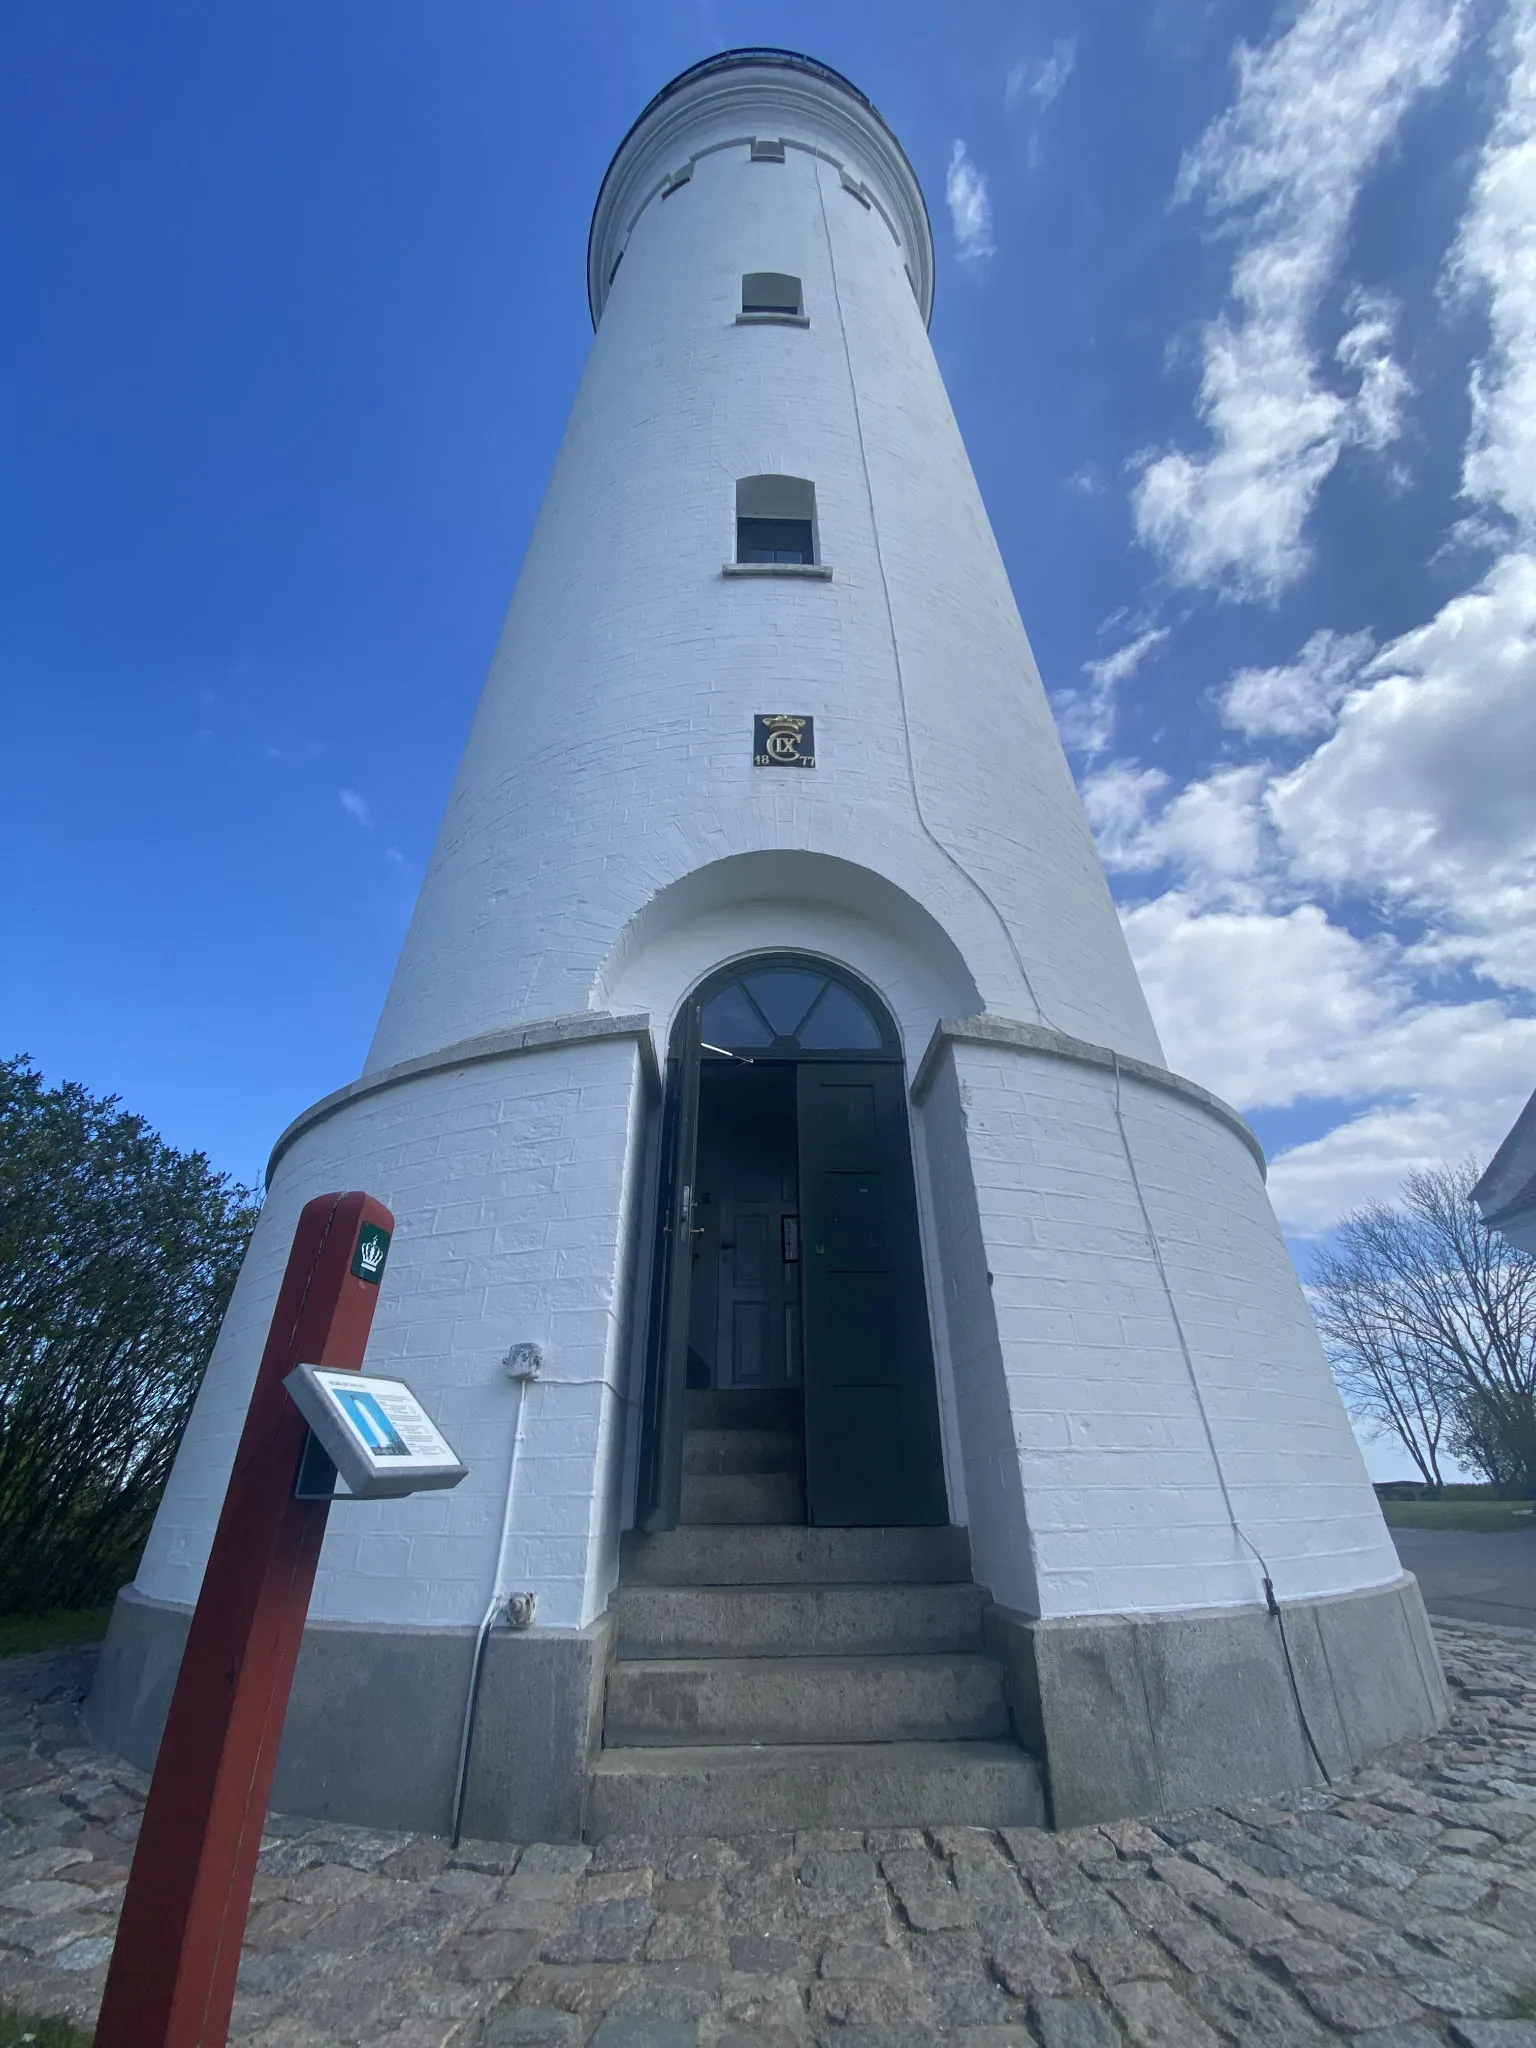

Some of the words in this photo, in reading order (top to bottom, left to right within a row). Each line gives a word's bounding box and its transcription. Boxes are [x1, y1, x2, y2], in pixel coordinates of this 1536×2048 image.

[775, 737, 797, 753] IX
[754, 754, 770, 766] 18
[799, 756, 815, 766] 77
